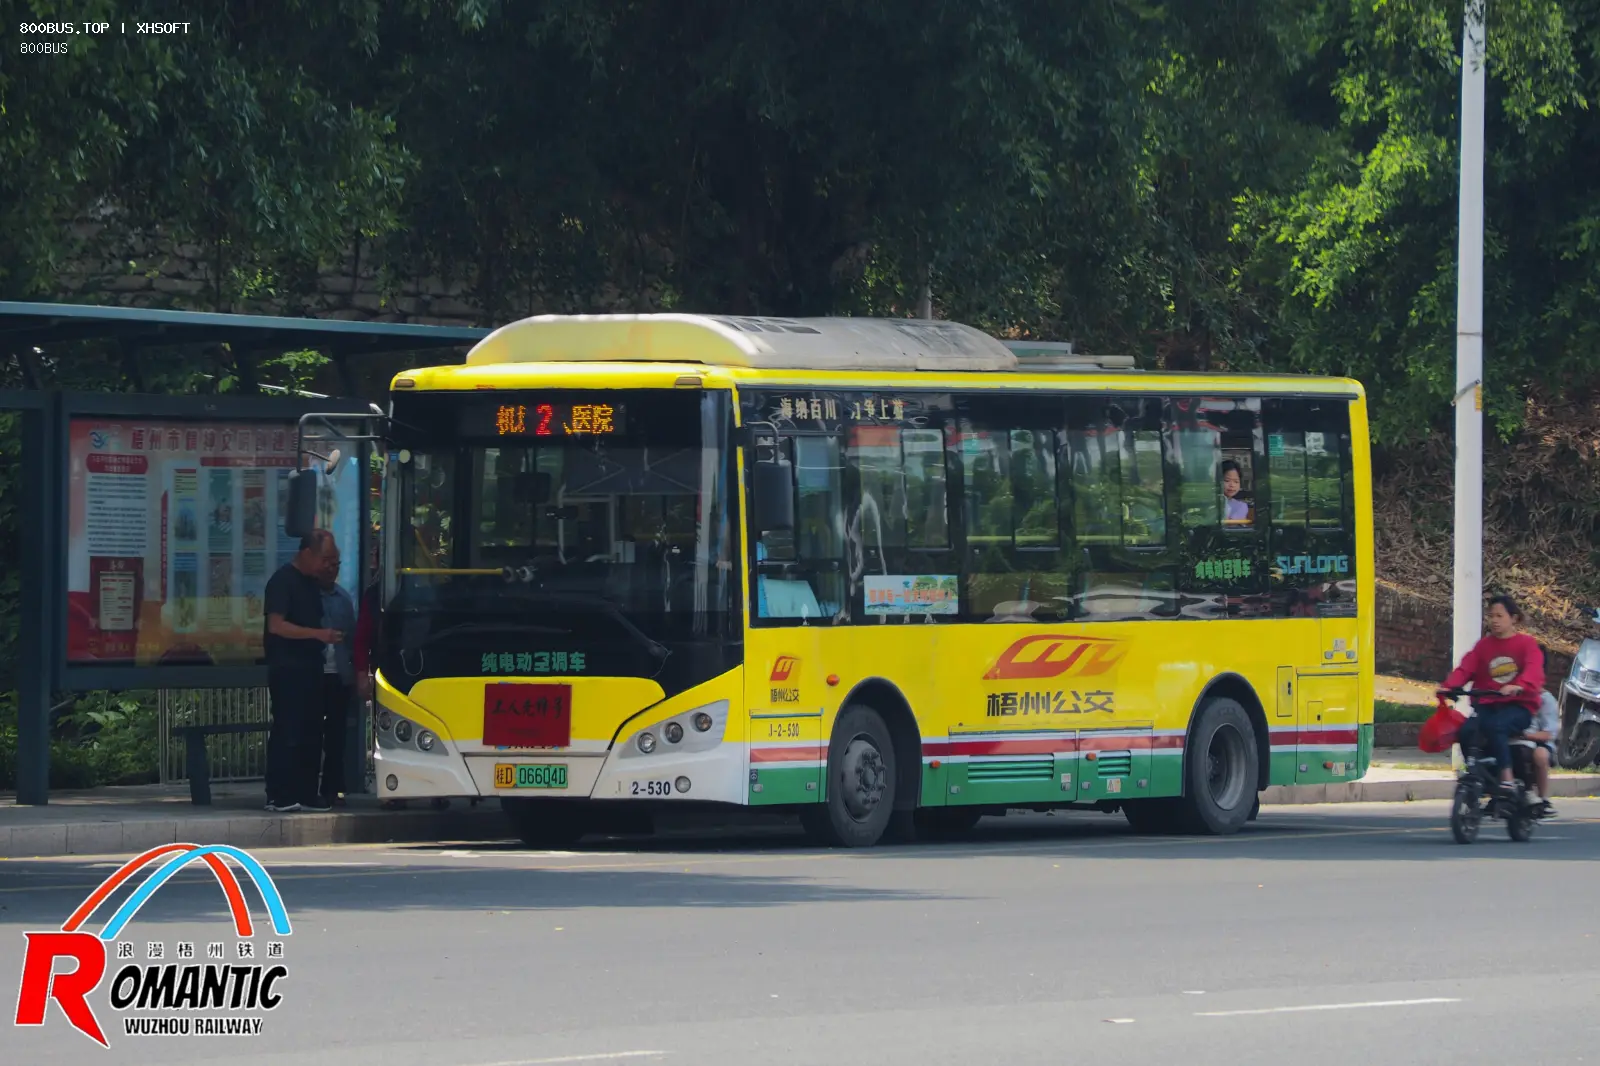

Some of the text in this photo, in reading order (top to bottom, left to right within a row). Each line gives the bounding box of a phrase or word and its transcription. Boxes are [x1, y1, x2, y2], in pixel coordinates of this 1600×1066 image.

[535, 403, 552, 435] 2
[563, 403, 614, 435] 医院
[1276, 554, 1348, 574] SUNLONG
[481, 651, 586, 672] 纯电动空调车
[770, 688, 800, 703] 梧州公交
[986, 690, 1114, 717] 梧州公交
[769, 723, 800, 738] J-2-530
[632, 780, 671, 796] 2-530
